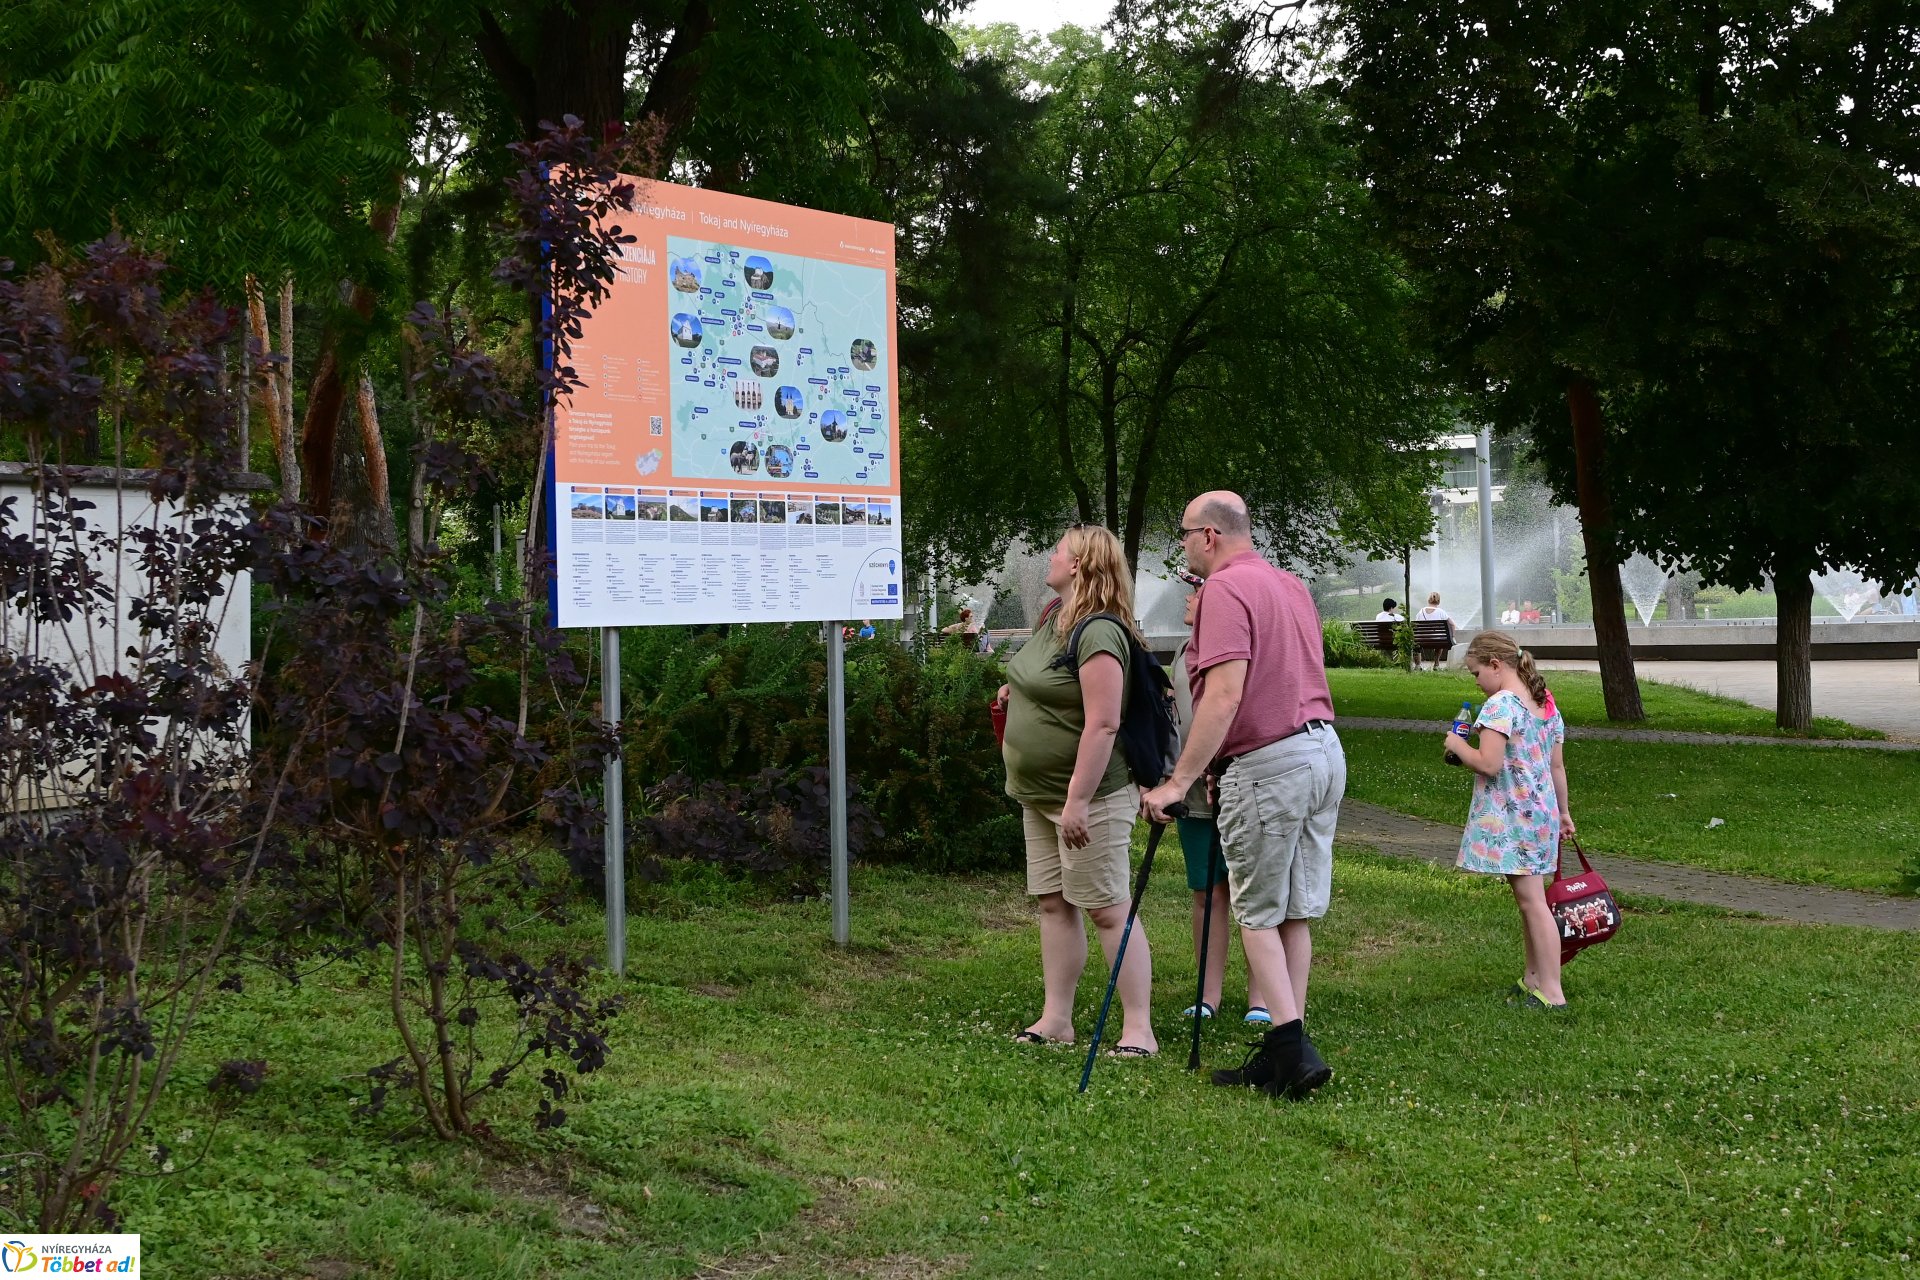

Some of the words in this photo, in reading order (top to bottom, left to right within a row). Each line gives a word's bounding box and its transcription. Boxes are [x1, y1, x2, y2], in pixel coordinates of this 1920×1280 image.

[698, 211, 721, 229] Tokaj
[723, 218, 738, 230] and
[740, 219, 789, 238] Nyíregyháza
[620, 265, 647, 284] HISTORY
